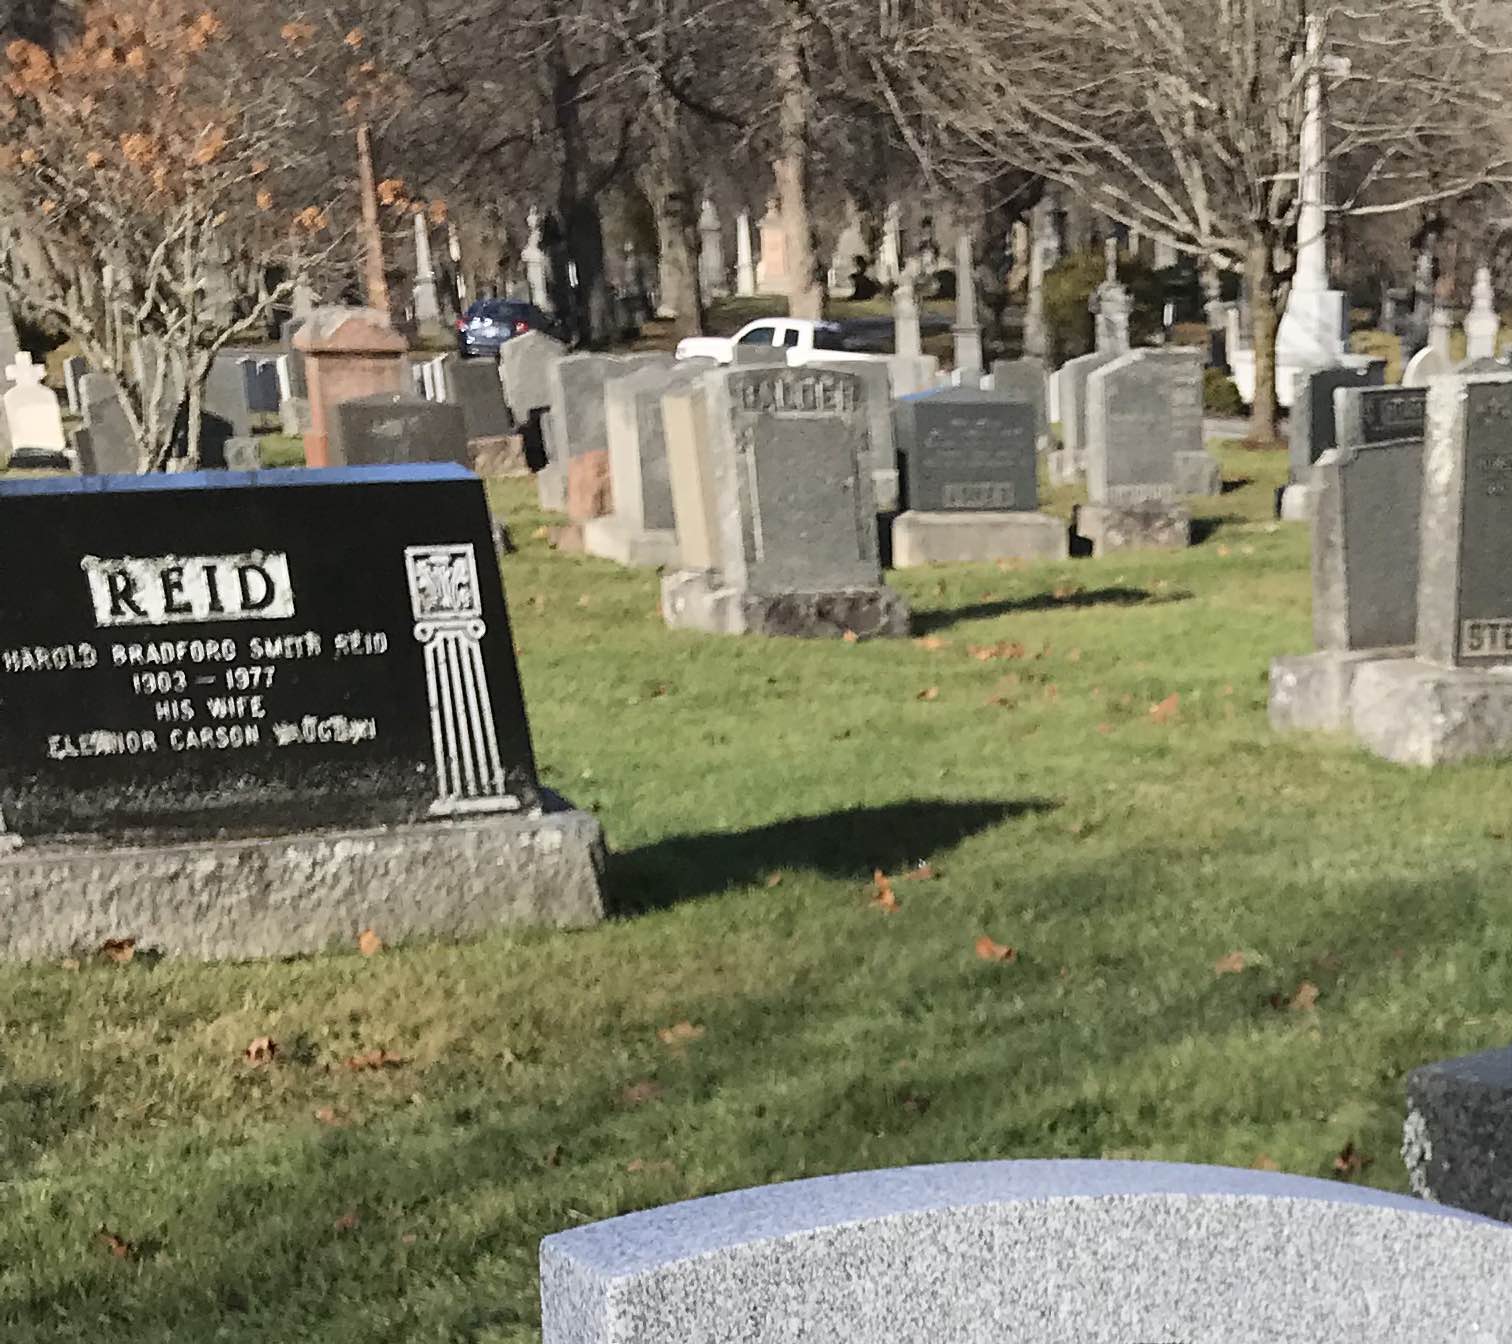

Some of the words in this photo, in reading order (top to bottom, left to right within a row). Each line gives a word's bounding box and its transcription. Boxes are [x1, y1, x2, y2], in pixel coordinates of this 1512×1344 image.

[105, 564, 276, 617] REID
[1, 642, 98, 672] HAROLD
[112, 638, 236, 667] BRADFORD
[250, 630, 322, 660] SMITH
[334, 629, 389, 659] REID
[133, 670, 187, 695] 1903
[225, 665, 275, 690] 1977
[155, 697, 195, 722] HIS
[207, 695, 266, 720] WIFE
[170, 724, 260, 752] CARSON
